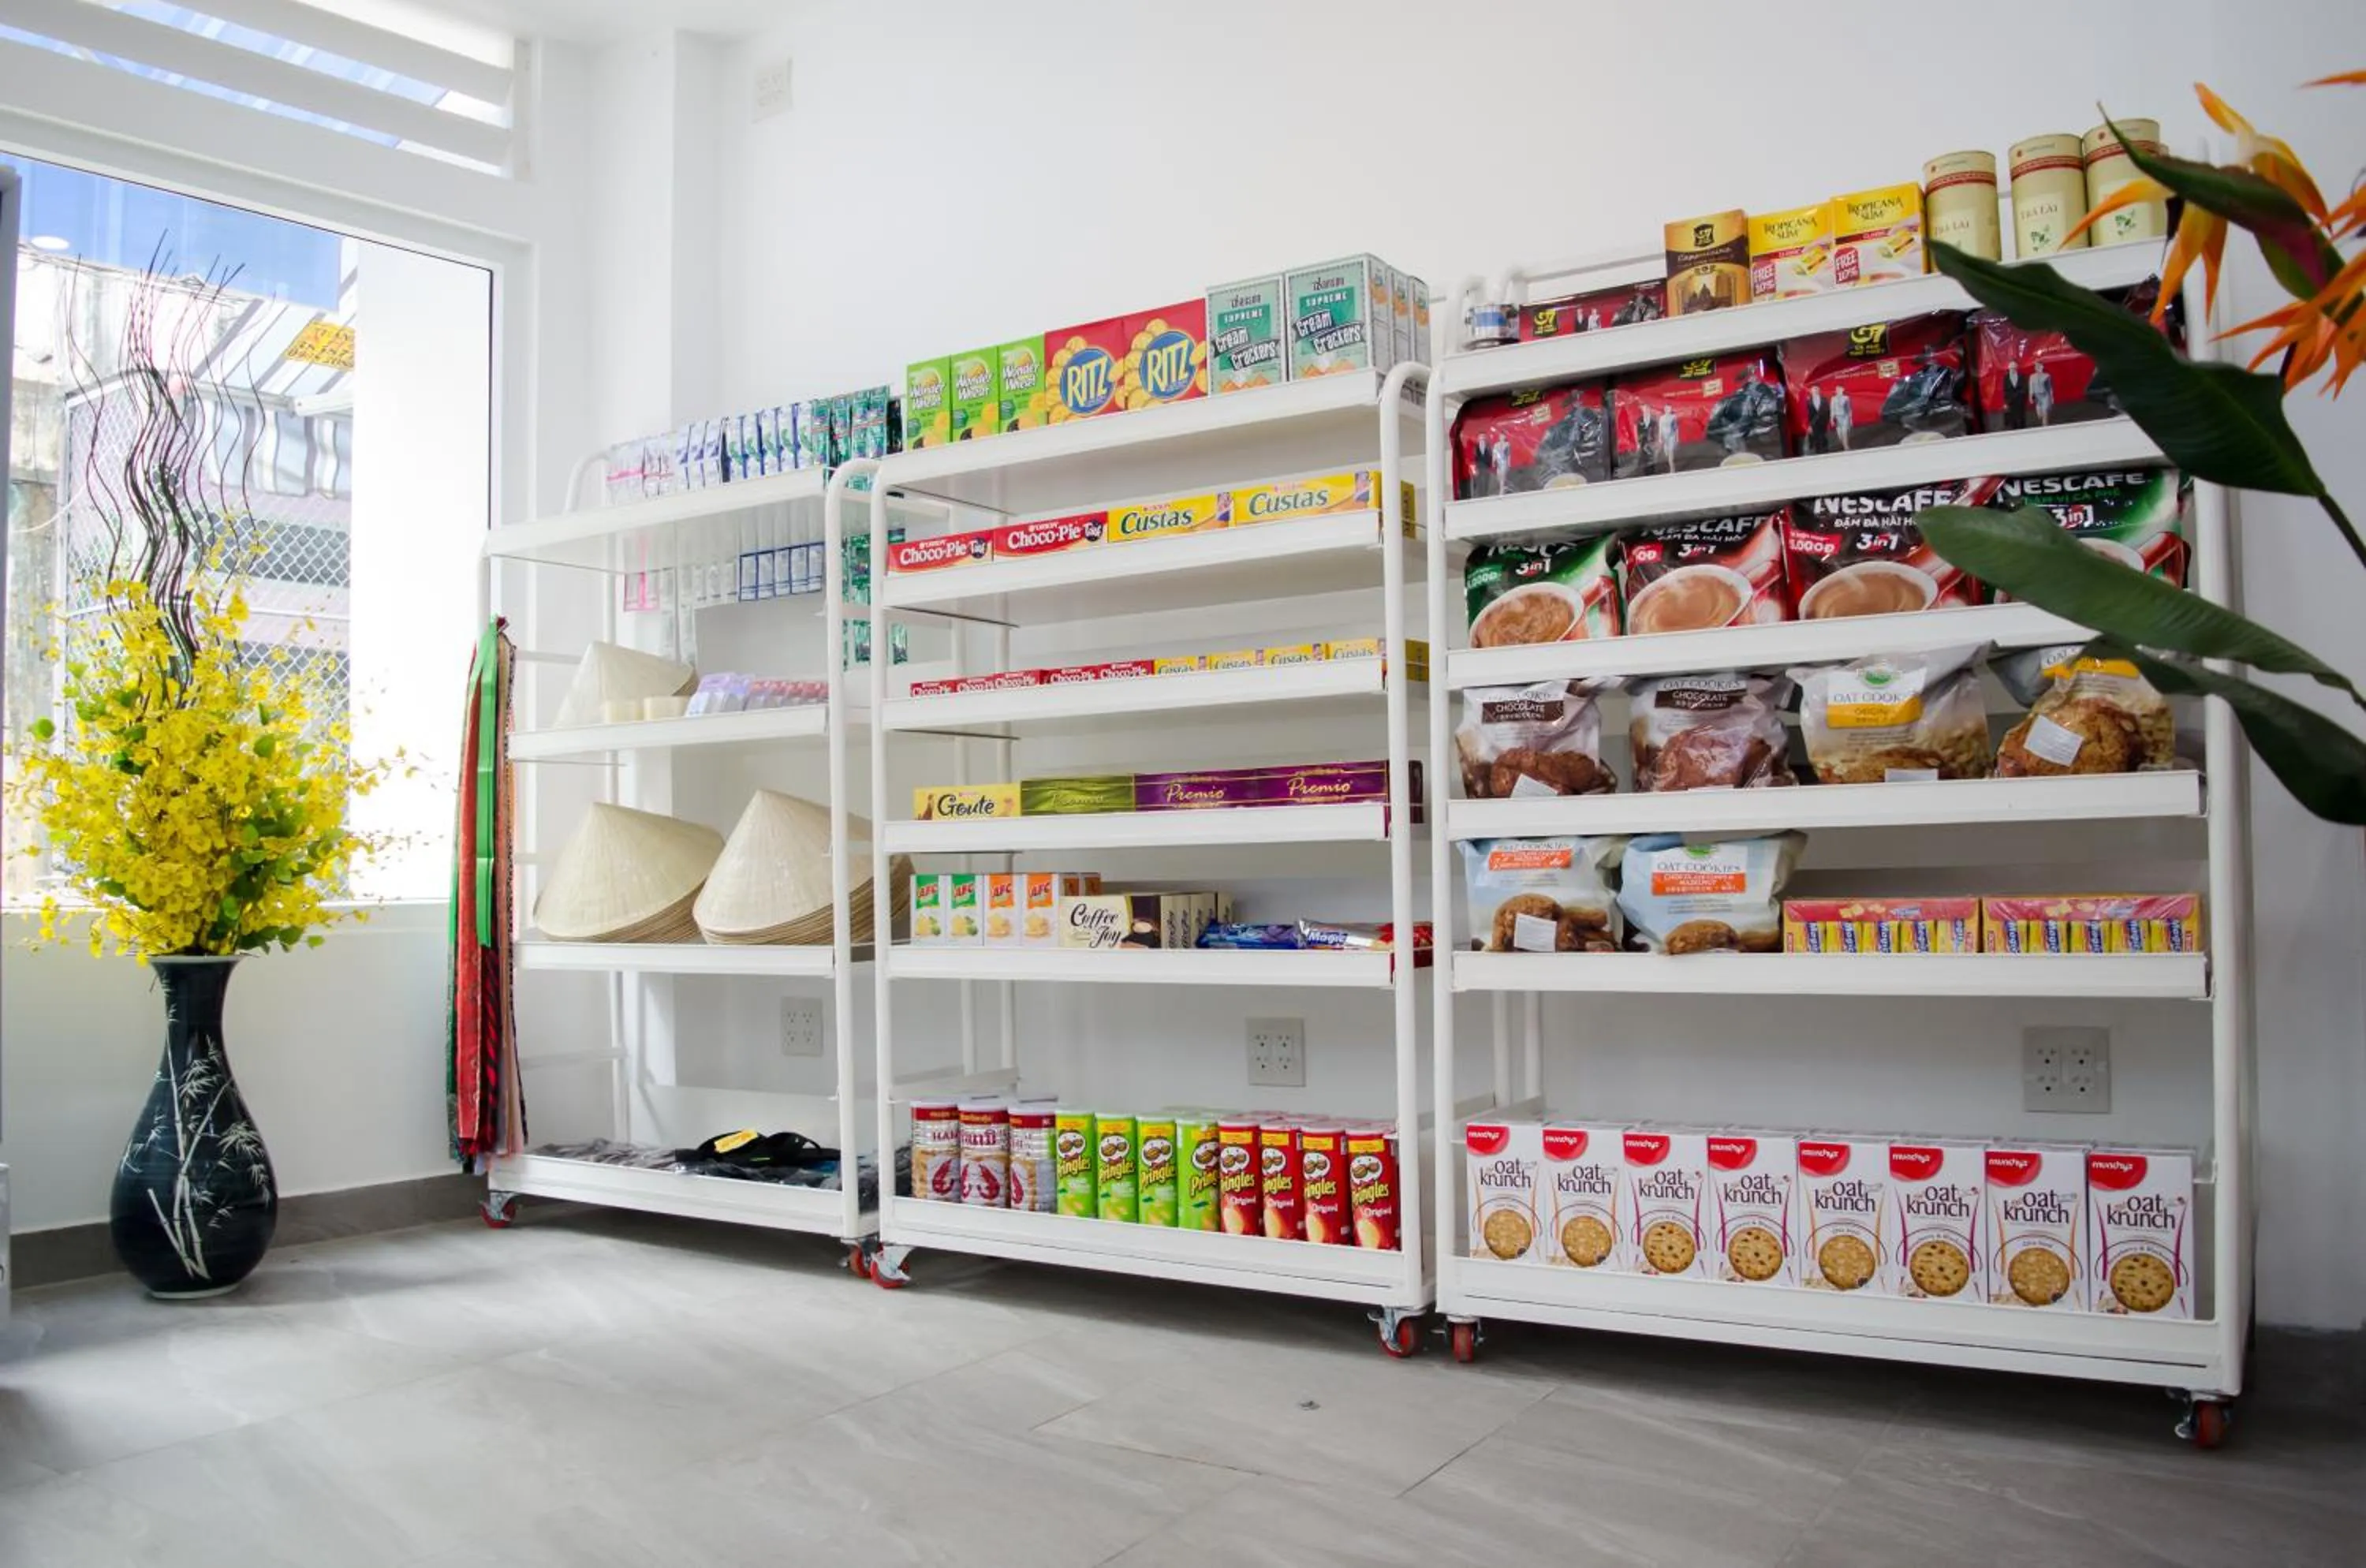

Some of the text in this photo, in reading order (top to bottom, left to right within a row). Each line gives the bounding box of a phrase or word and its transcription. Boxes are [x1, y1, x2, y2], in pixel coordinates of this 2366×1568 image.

[1296, 310, 1333, 338] Cream
[1851, 323, 1887, 343] G7
[1215, 327, 1249, 353] Cream
[1148, 338, 1189, 393] RITZ
[1067, 355, 1108, 408] RITZ
[1249, 489, 1329, 517] Custas
[1121, 508, 1192, 535] Custas
[1856, 532, 1899, 551] 3in1
[1166, 782, 1226, 803] Premio
[1287, 776, 1351, 797] Premio
[1070, 903, 1120, 929] Coffee
[1089, 925, 1121, 948] Joy
[1308, 931, 1346, 944] Magic
[1495, 1159, 1521, 1175] oat
[1573, 1163, 1601, 1181] oat
[1654, 1169, 1684, 1185] oat
[1480, 1167, 1531, 1189] krunch
[1558, 1173, 1611, 1194] krunch
[1741, 1174, 1771, 1190] oat
[1832, 1179, 1865, 1197] oat
[1639, 1178, 1695, 1200] krunch
[1724, 1183, 1782, 1204] krunch
[1924, 1184, 1959, 1203] oat
[2023, 1189, 2058, 1208] oat
[1815, 1189, 1876, 1212] krunch
[1906, 1193, 1970, 1217] krunch
[2127, 1193, 2163, 1212] oat
[2004, 1200, 2069, 1224] krunch
[2107, 1204, 2175, 1229] krunch
